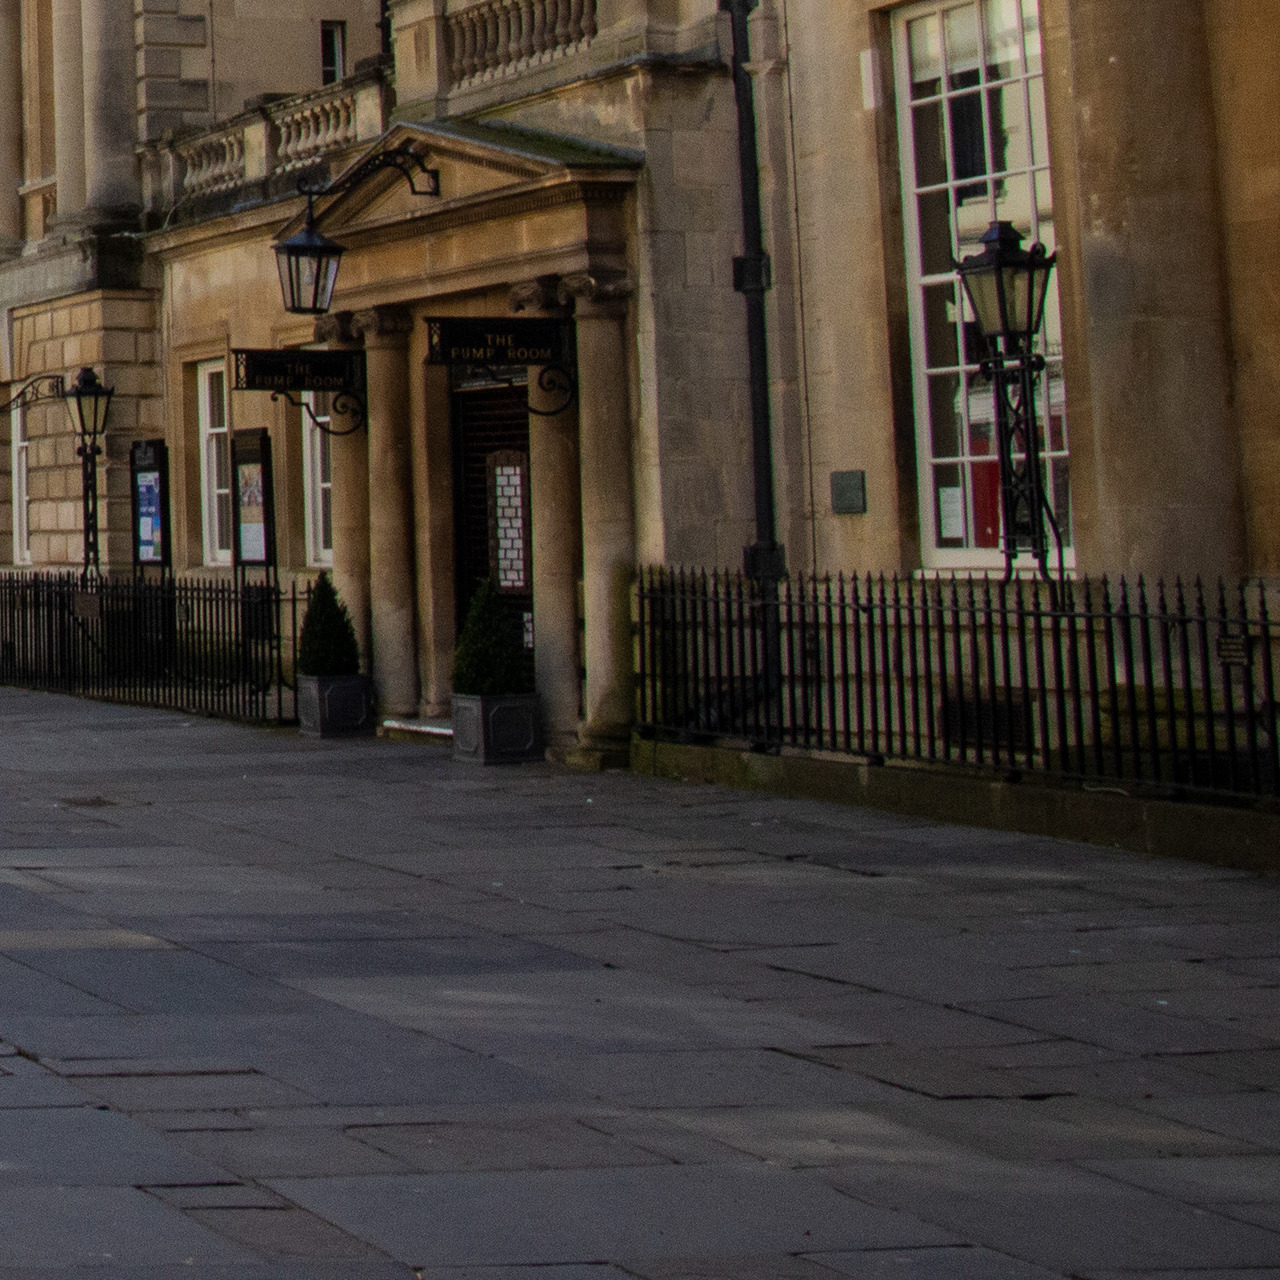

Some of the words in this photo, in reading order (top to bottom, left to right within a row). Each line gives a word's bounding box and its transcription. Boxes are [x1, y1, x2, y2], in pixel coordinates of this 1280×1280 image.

[486, 333, 515, 346] THE
[450, 347, 496, 360] PUMP
[506, 348, 553, 360] ROOM
[285, 363, 313, 375] THE
[255, 375, 295, 387] PUMP
[304, 376, 345, 388] ROOM
